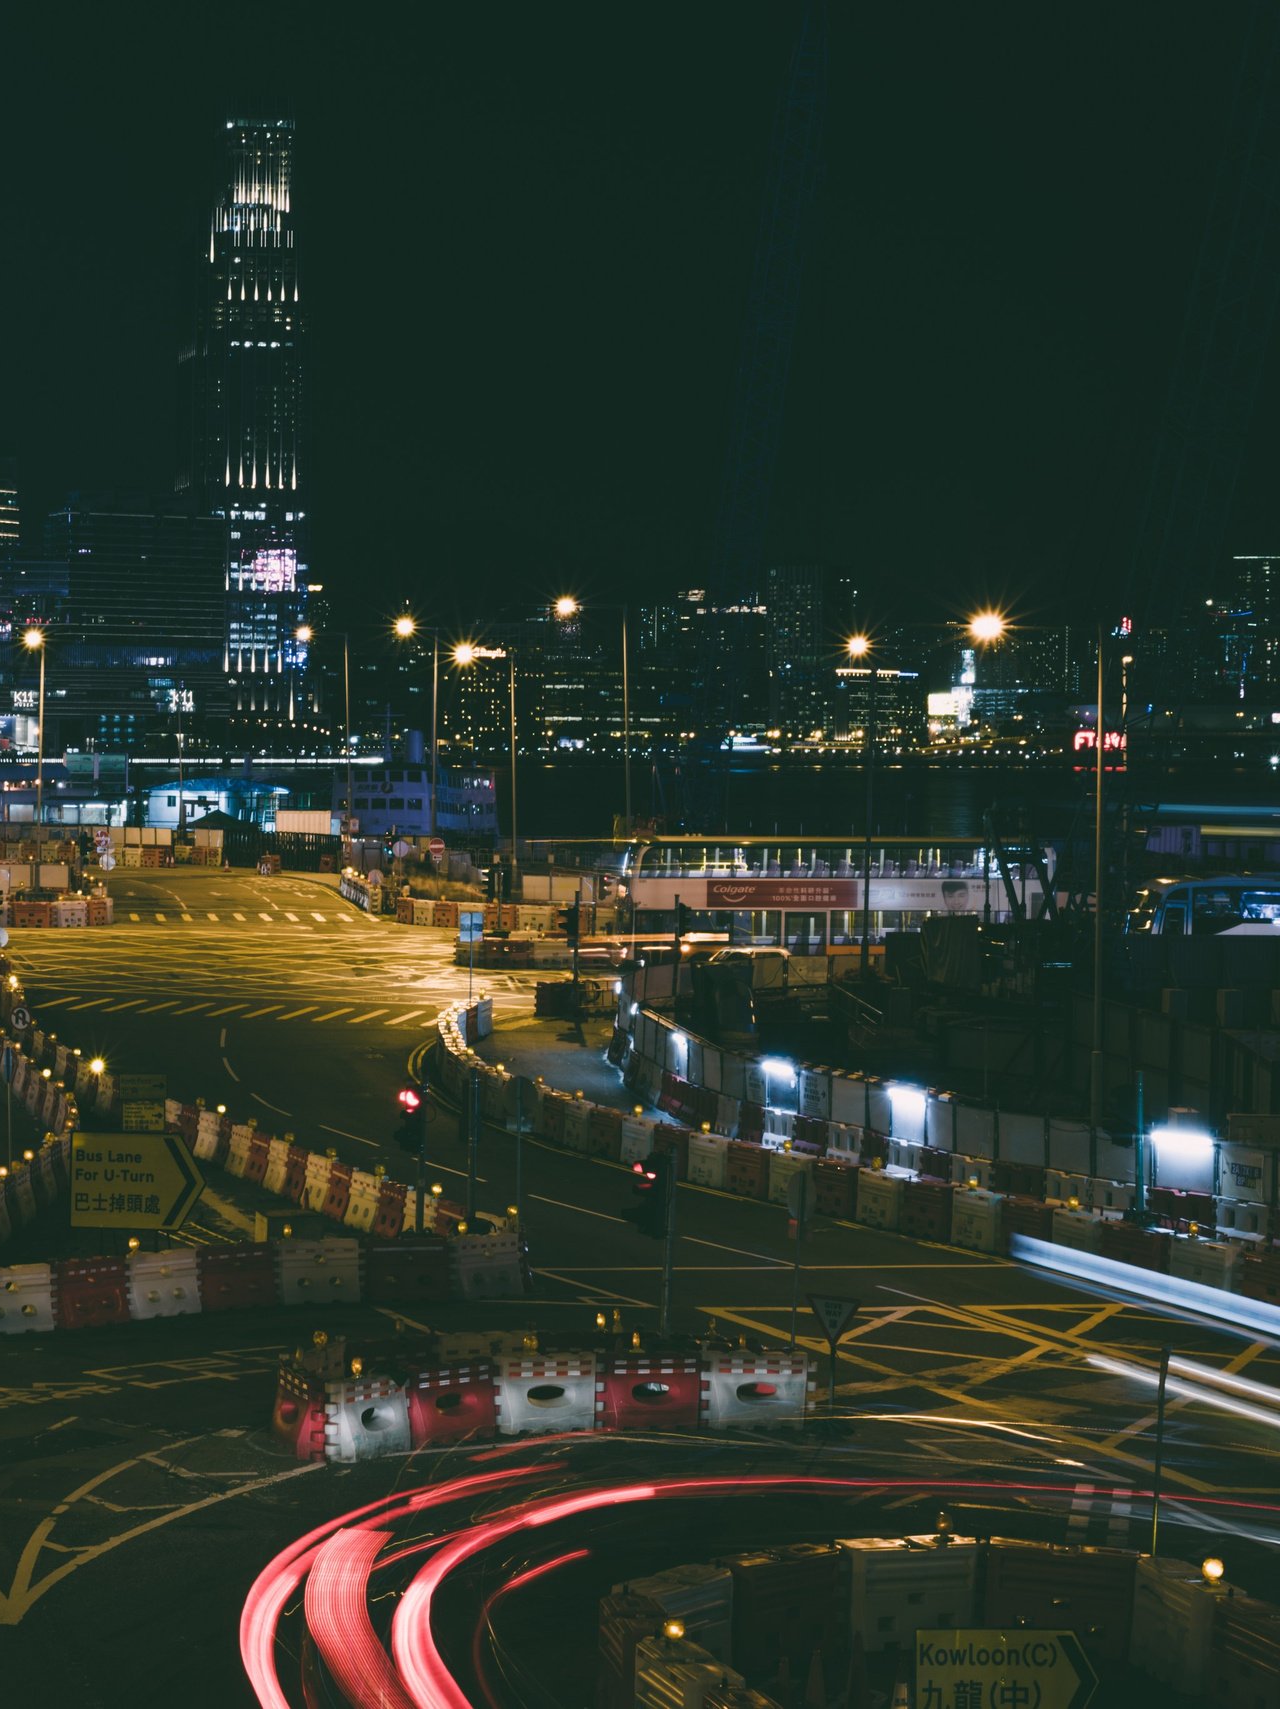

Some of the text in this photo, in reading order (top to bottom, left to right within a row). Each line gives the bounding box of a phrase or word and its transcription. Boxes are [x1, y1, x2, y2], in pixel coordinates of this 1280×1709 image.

[14, 690, 34, 703] K11
[713, 884, 756, 895] Colgate
[75, 1149, 142, 1163] Bus Lane
[75, 1168, 155, 1183] For U-Turn
[74, 1192, 161, 1214] 巴士掉頭處
[824, 1301, 843, 1310] GIVE
[824, 1309, 843, 1317] WAY
[920, 1642, 1057, 1668] Kowloon(C)
